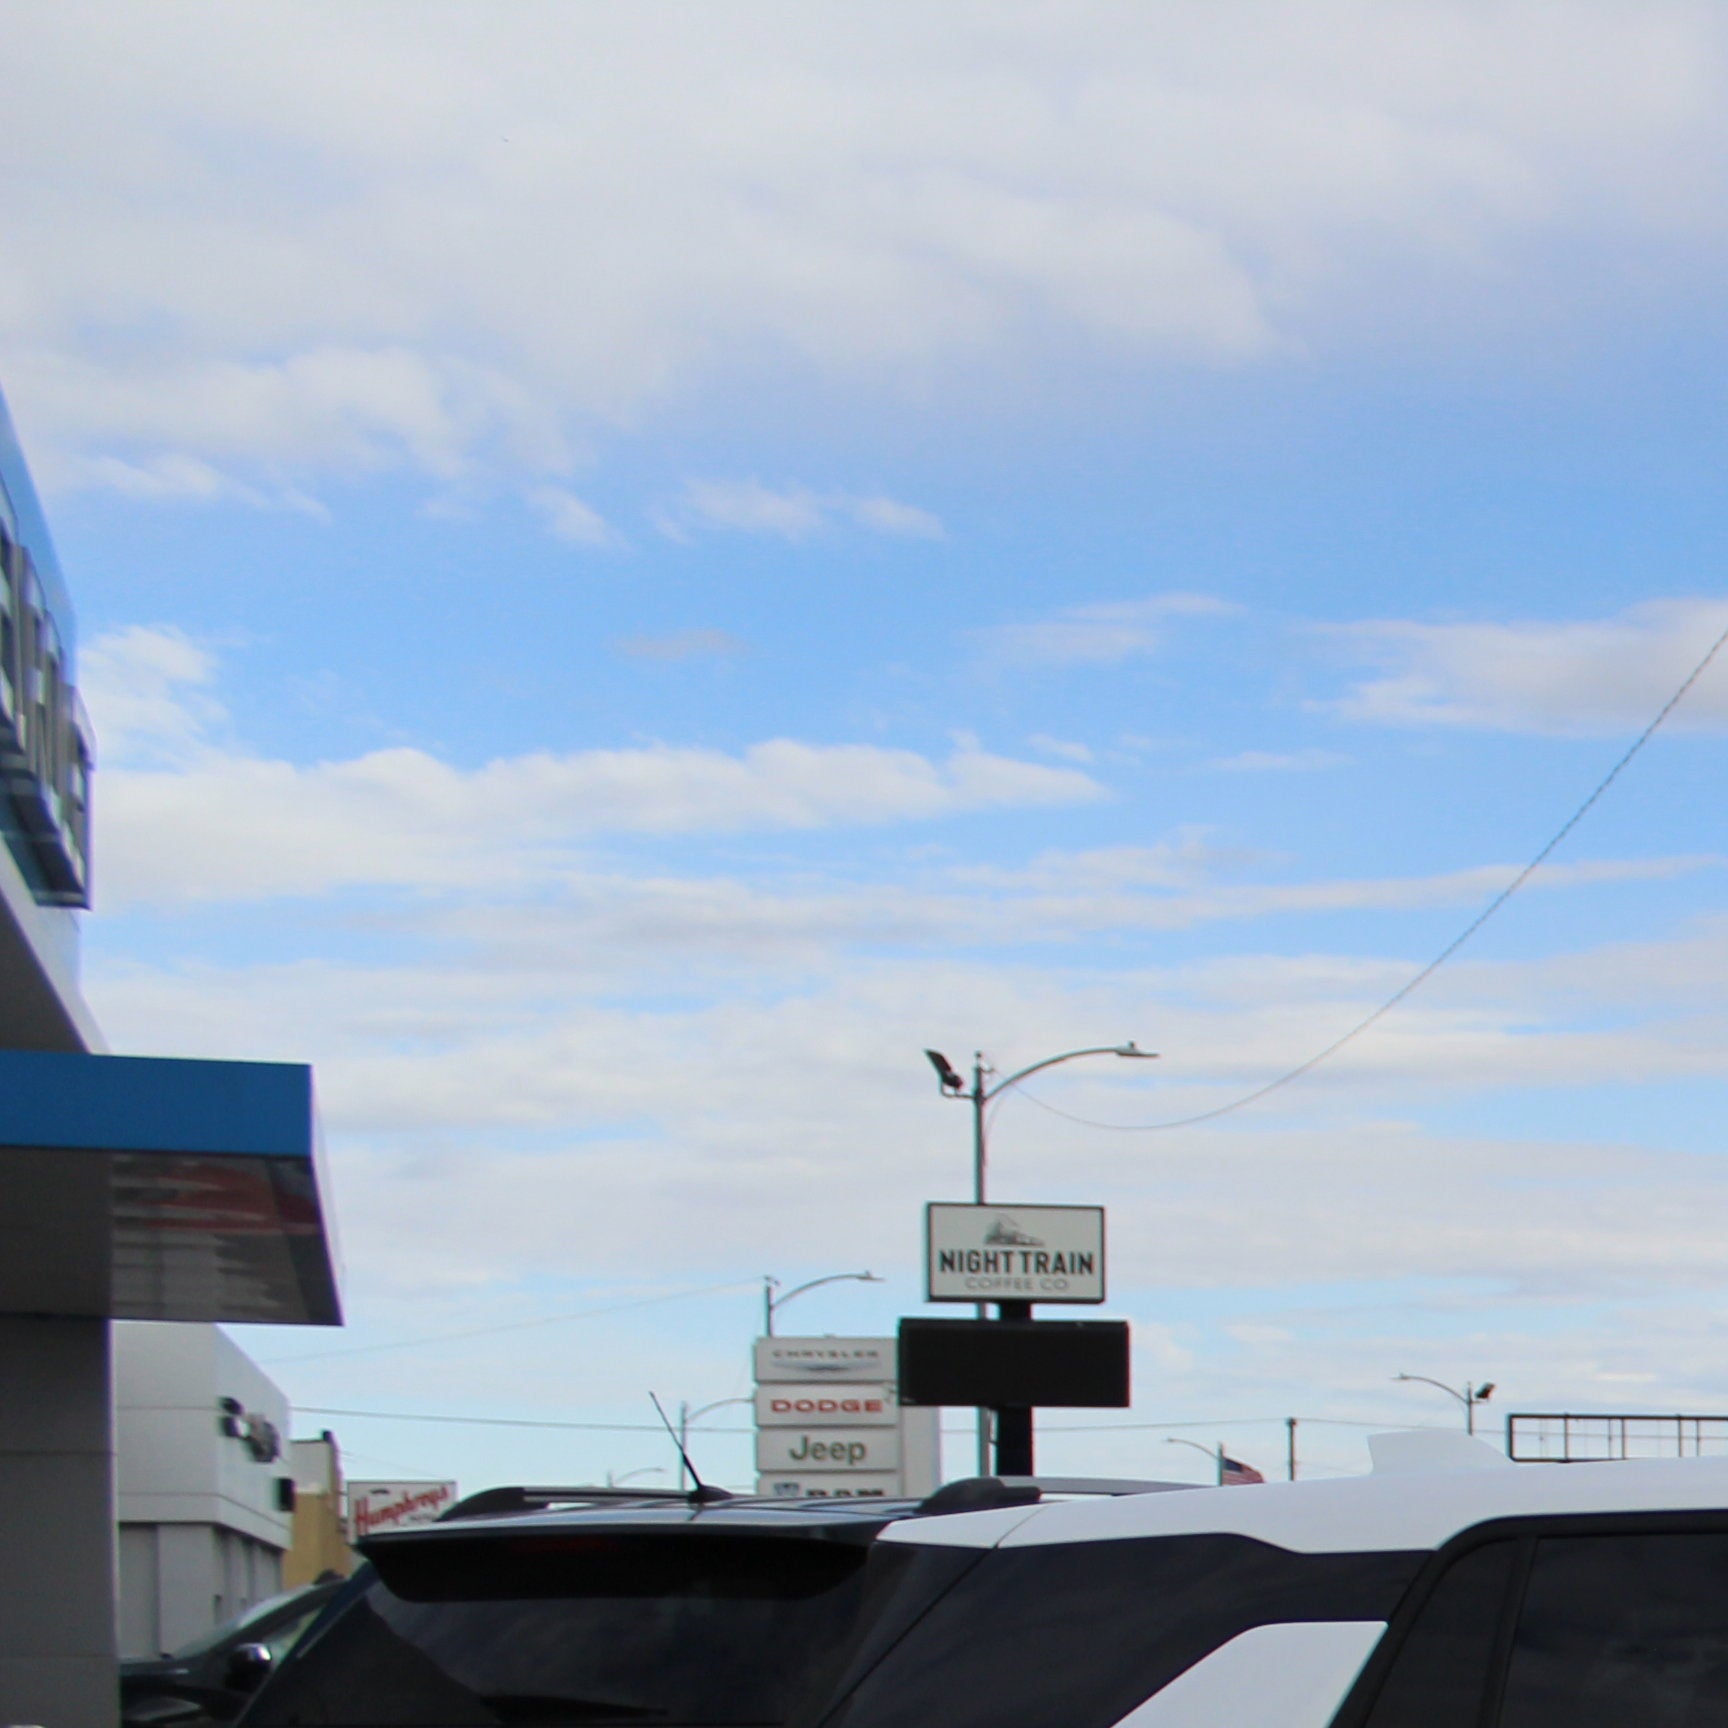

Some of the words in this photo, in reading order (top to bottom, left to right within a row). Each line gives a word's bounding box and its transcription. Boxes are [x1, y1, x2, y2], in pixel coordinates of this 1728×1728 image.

[939, 1250, 1014, 1273] NIGHT
[1020, 1251, 1095, 1275] TRAIN
[965, 1277, 1033, 1290] COFFEE
[771, 1399, 883, 1413] DODGE
[789, 1434, 867, 1466] Jeep
